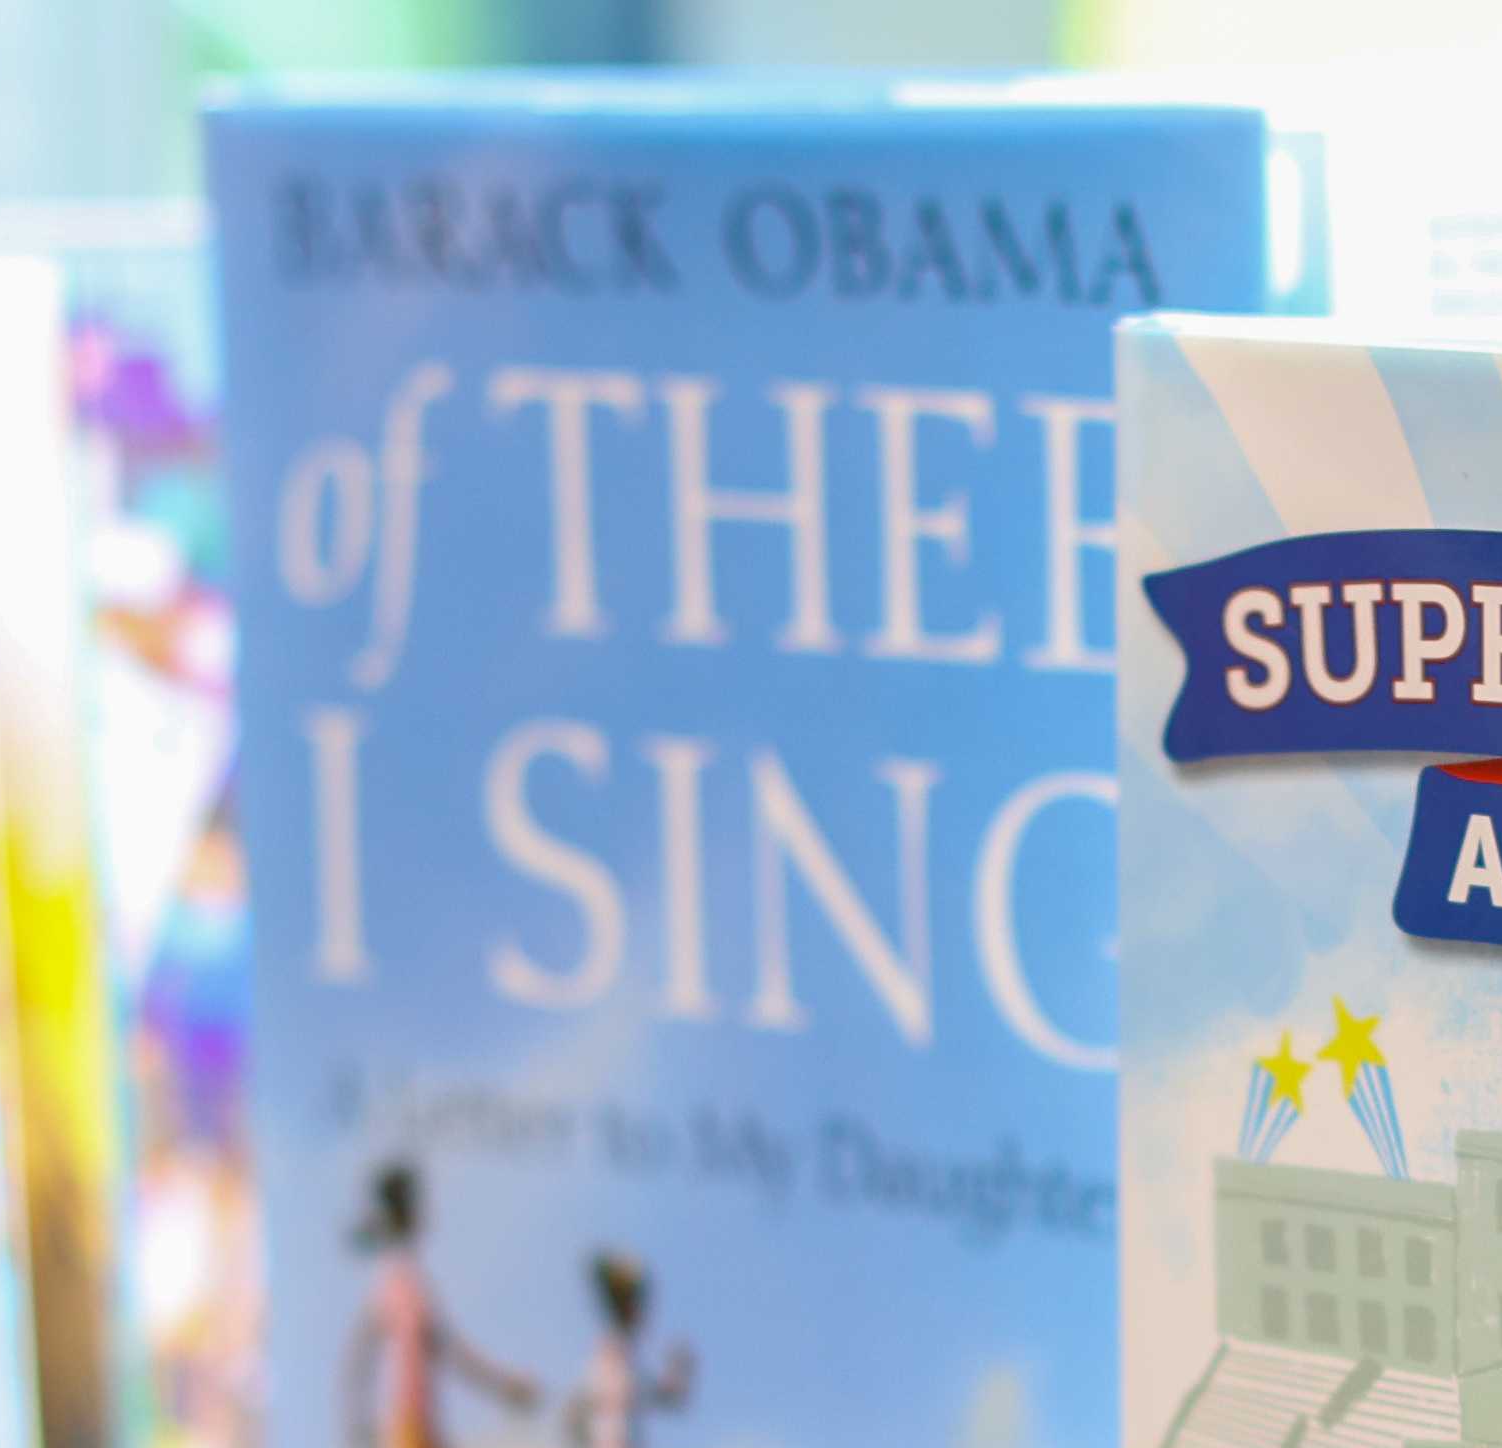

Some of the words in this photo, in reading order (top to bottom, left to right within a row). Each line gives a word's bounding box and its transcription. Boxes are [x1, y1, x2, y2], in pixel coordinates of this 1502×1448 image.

[273, 170, 685, 298] BARACK
[722, 186, 1164, 310] OBAMA
[277, 361, 453, 690] of
[304, 706, 377, 988] I
[601, 1102, 674, 1172] to
[687, 1102, 793, 1220] My
